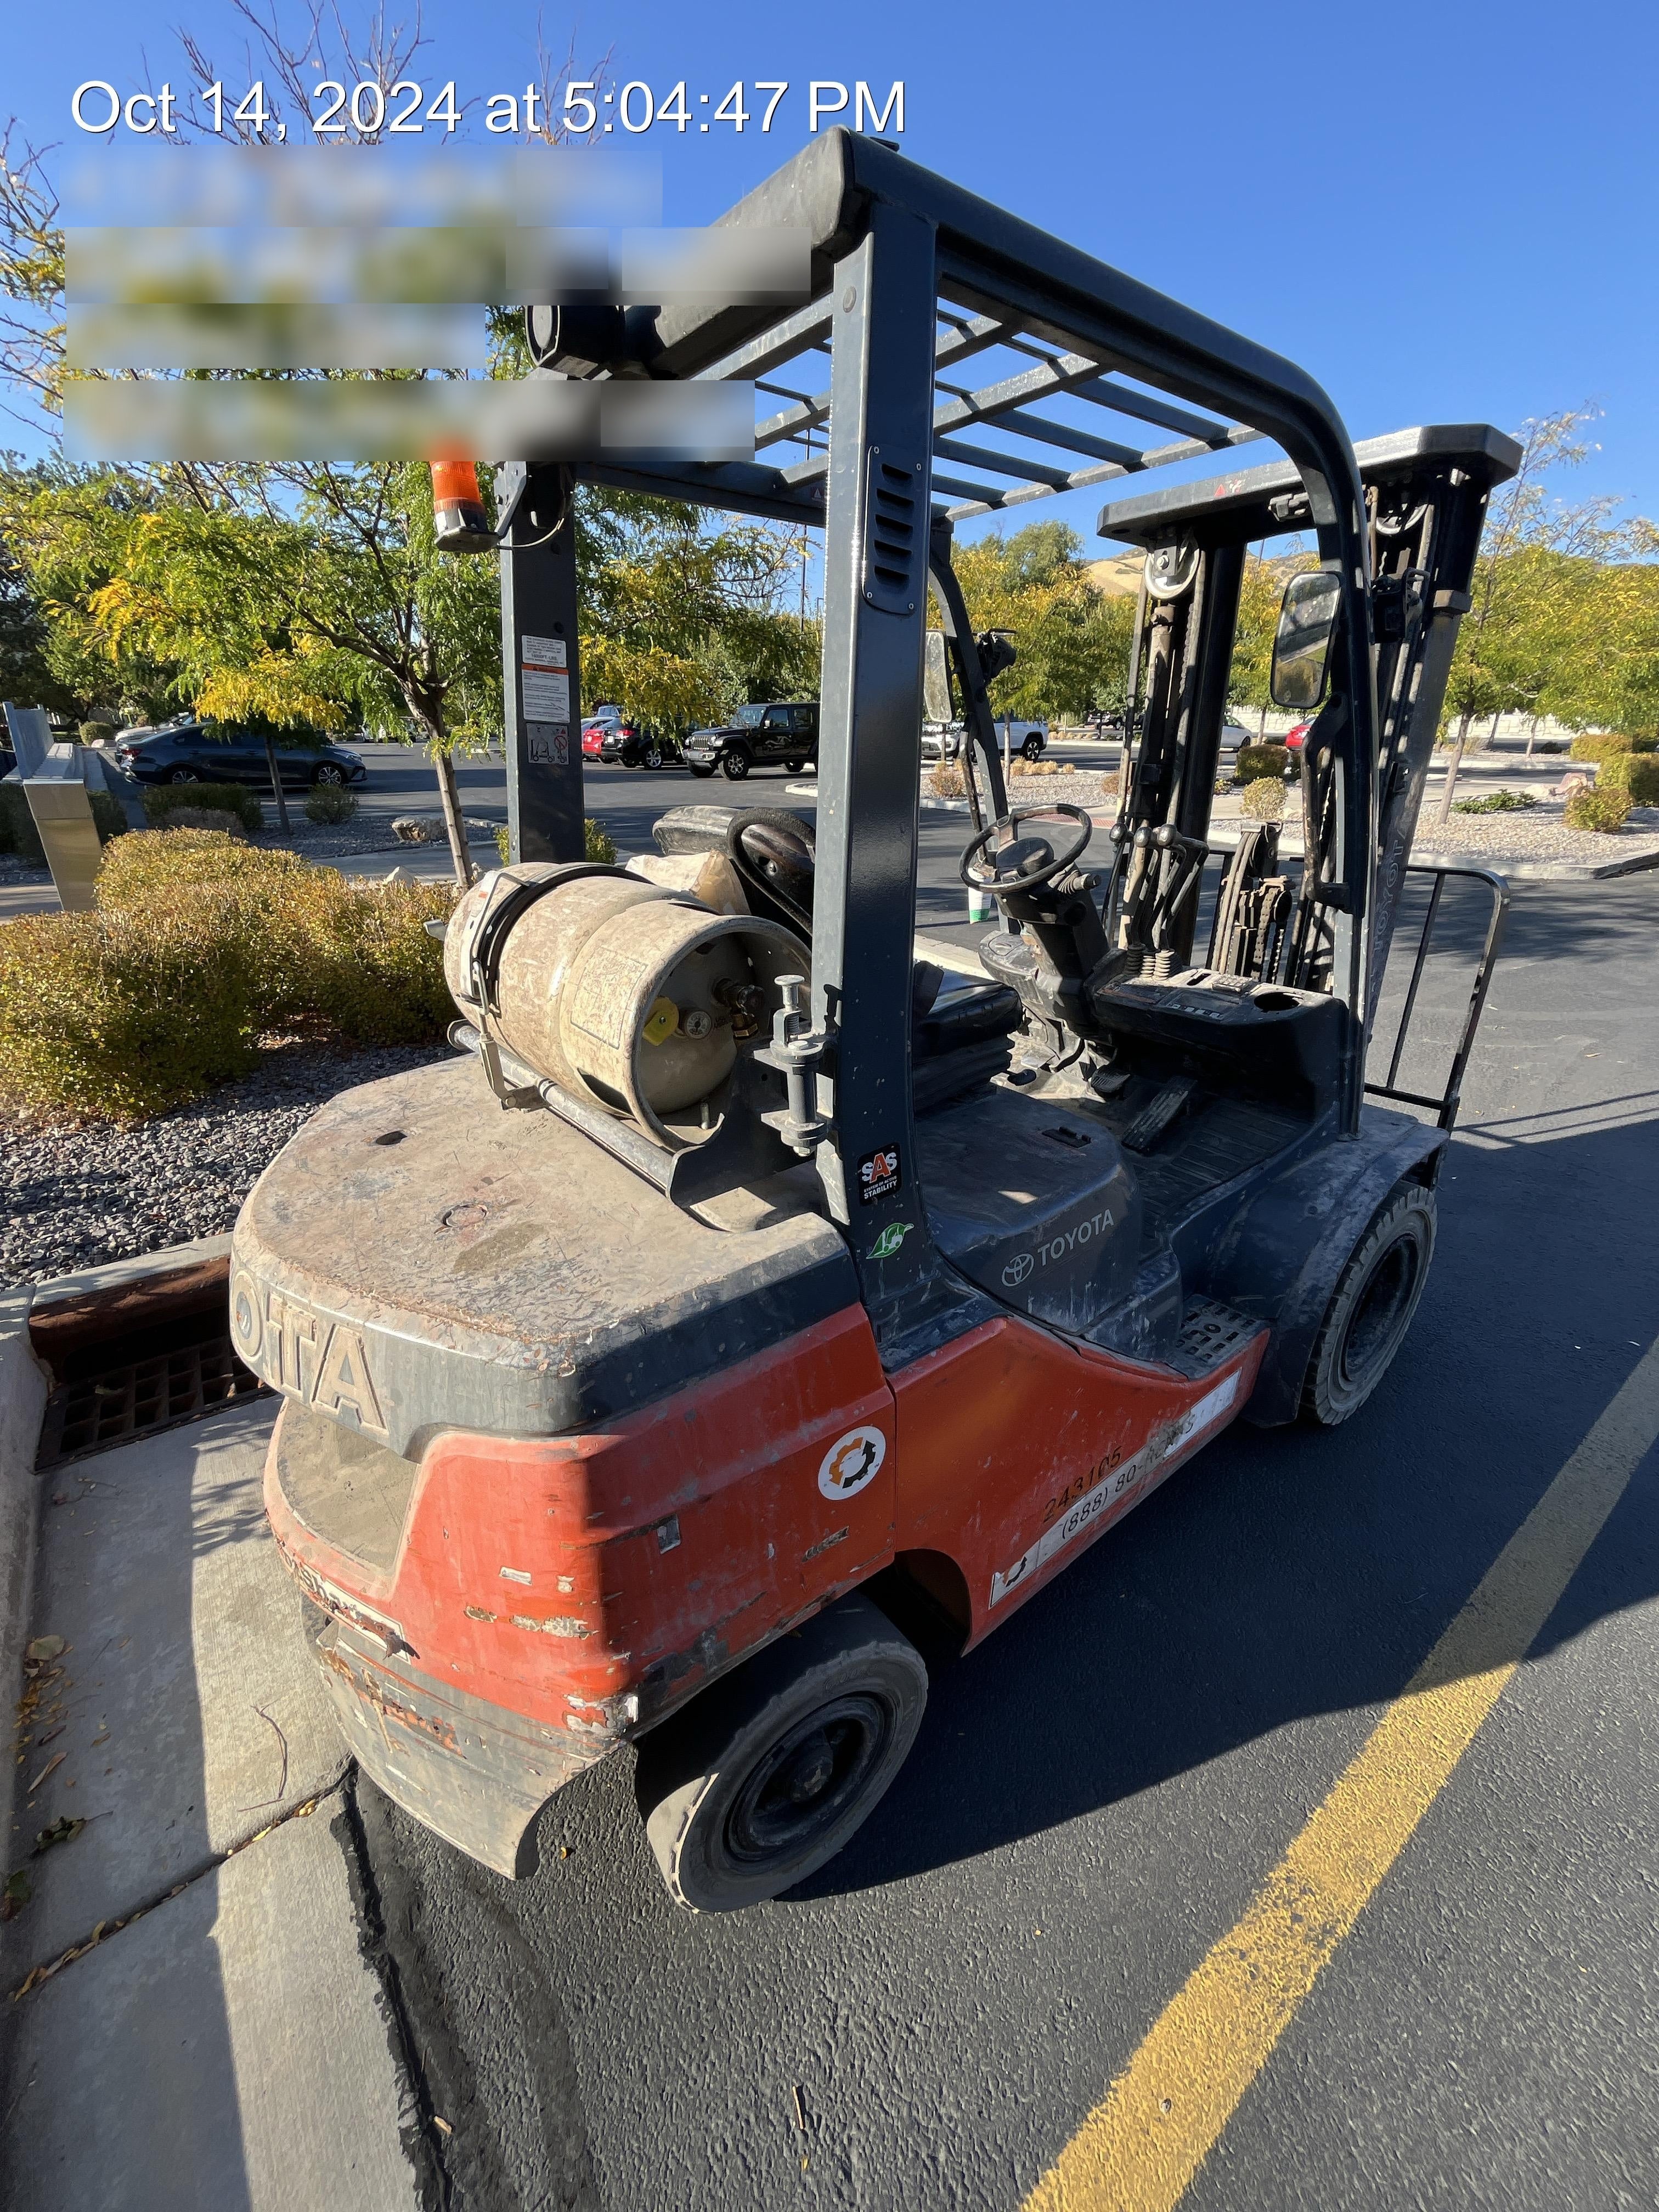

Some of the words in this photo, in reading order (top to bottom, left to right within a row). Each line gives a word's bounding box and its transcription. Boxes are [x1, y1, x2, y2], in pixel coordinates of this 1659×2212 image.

[861, 1152, 898, 1184] SAS
[864, 1179, 898, 1200] STABILITY
[1037, 1209, 1114, 1267] TOYOTA
[1062, 1487, 1108, 1539] (888)
